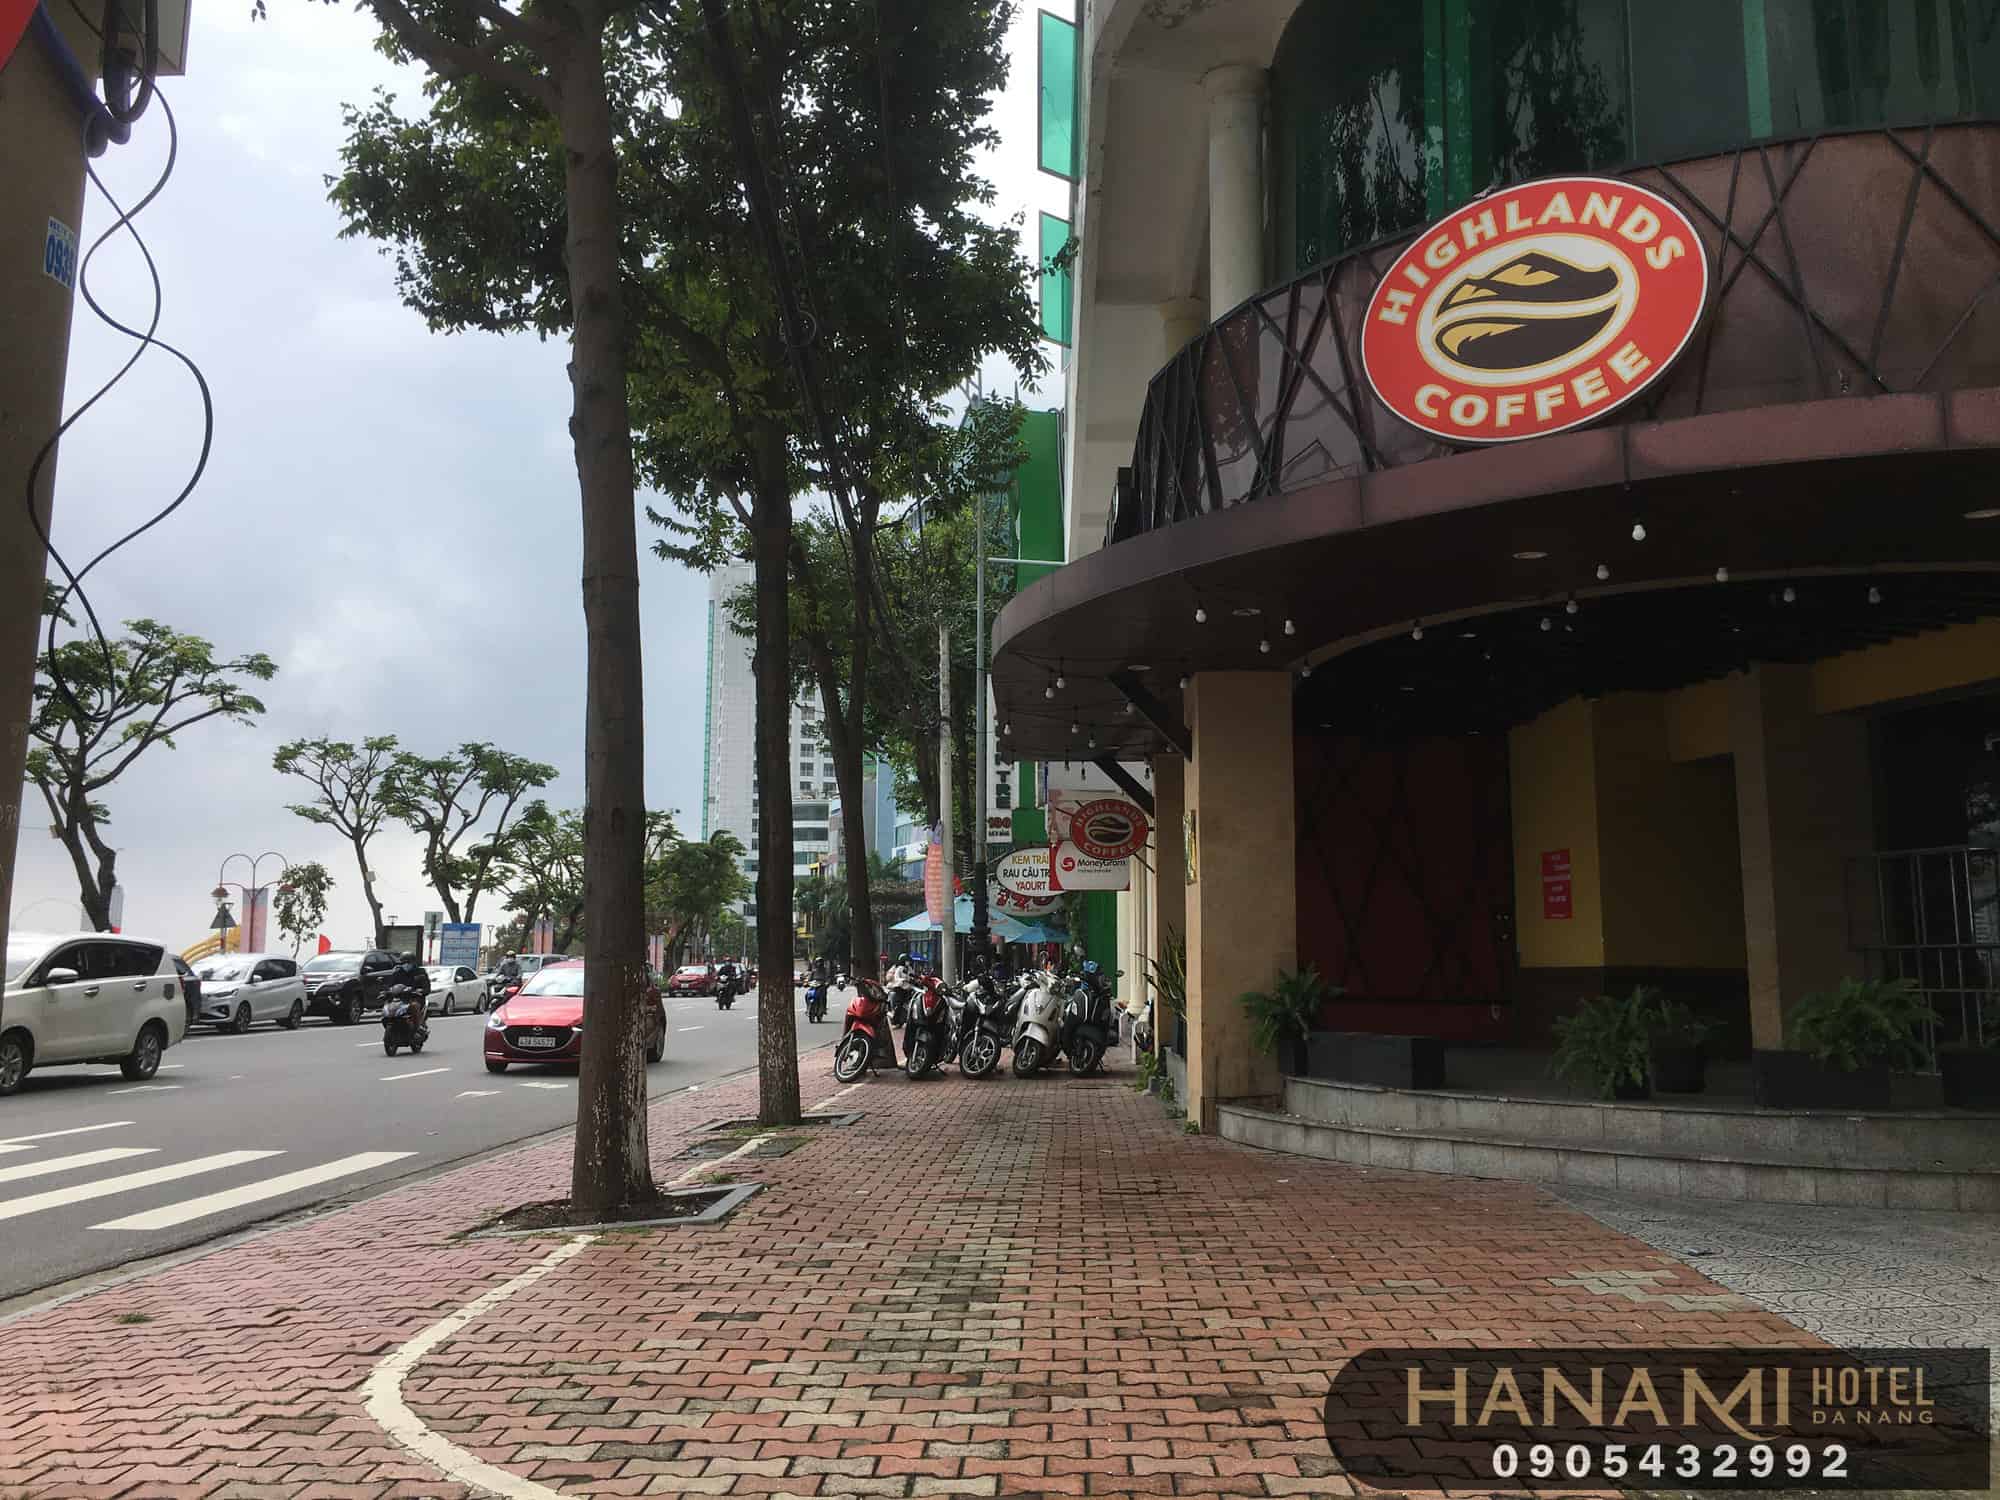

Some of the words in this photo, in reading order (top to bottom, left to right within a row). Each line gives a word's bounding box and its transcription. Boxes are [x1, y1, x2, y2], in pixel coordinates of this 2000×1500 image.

[1378, 191, 1686, 326] HIGHLANDS
[1414, 341, 1652, 428] COFFEE
[1011, 855, 1031, 865] KEM
[1002, 868, 1020, 878] RAU
[1016, 881, 1047, 891] YAOURT
